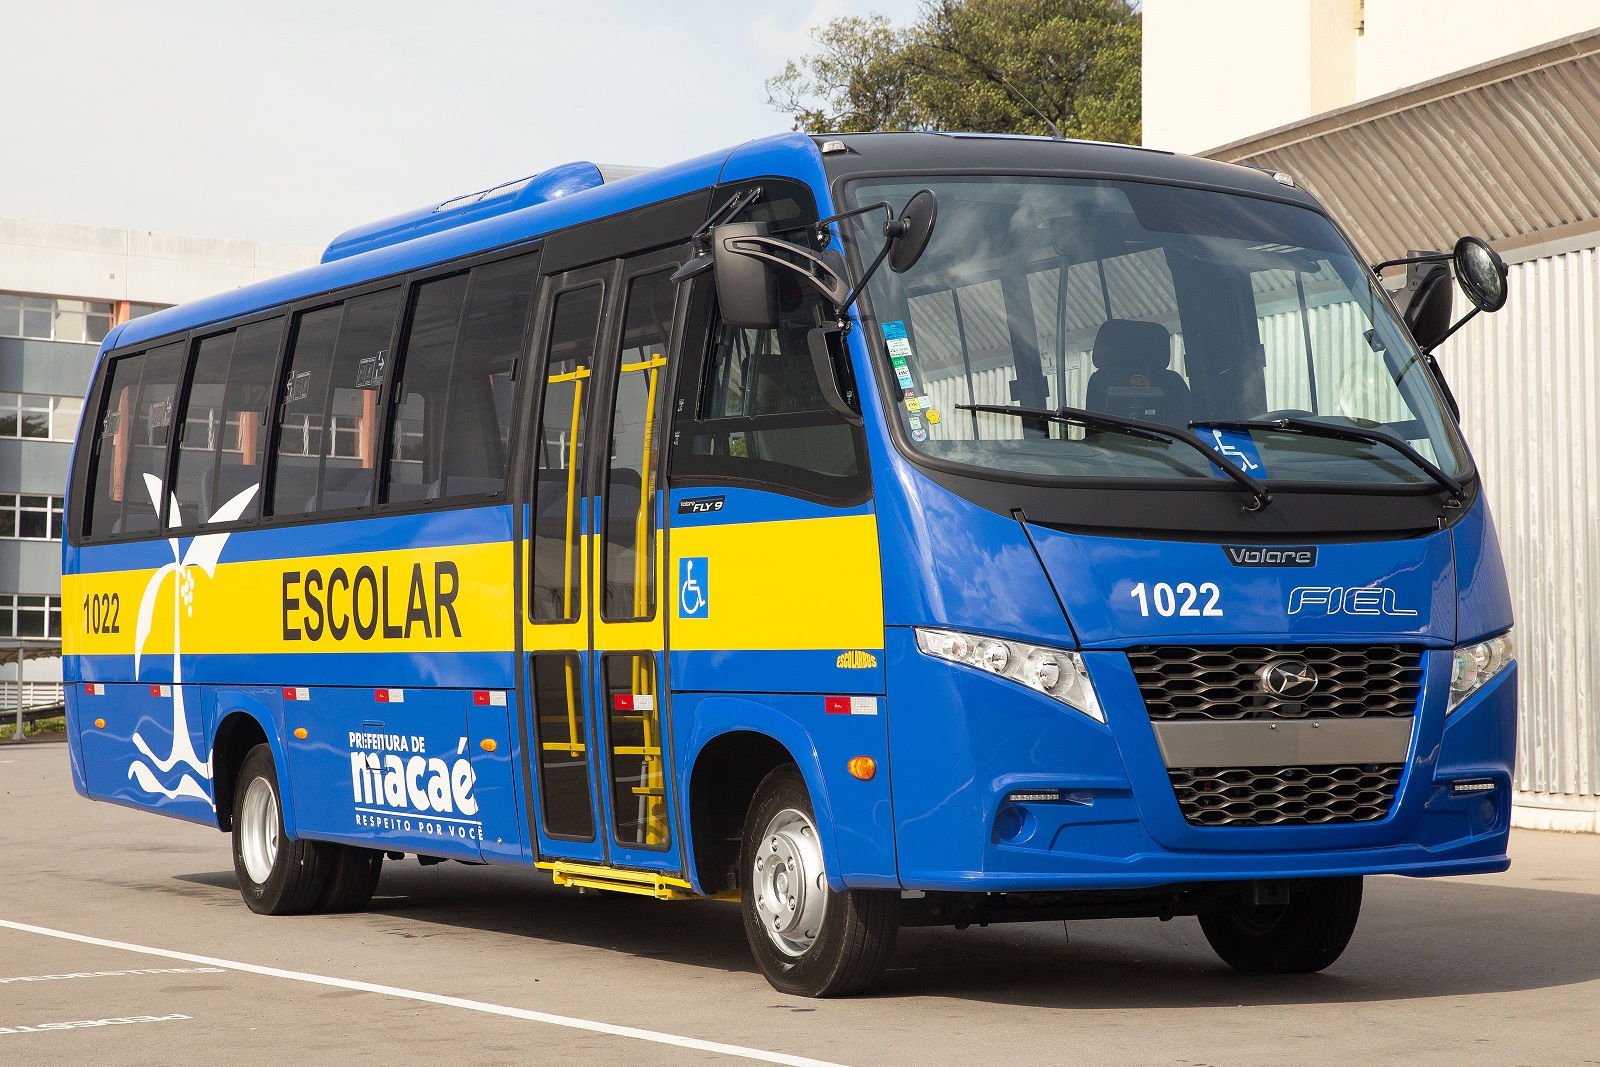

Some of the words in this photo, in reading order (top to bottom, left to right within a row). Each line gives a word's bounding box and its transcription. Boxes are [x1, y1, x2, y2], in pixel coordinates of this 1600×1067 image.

[693, 502, 713, 512] FLY
[714, 501, 724, 510] 9
[1229, 547, 1314, 564] Volare
[83, 592, 120, 634] 1022
[282, 560, 462, 642] ESCOLAR
[1130, 582, 1224, 617] 1022
[1287, 586, 1418, 616] FIEL
[348, 731, 409, 752] PREFEITURA
[411, 736, 426, 753] DE
[350, 736, 479, 816] macaé
[355, 814, 411, 832] RESPEITO
[418, 821, 443, 836] POR
[448, 825, 484, 841] VOCÊ
